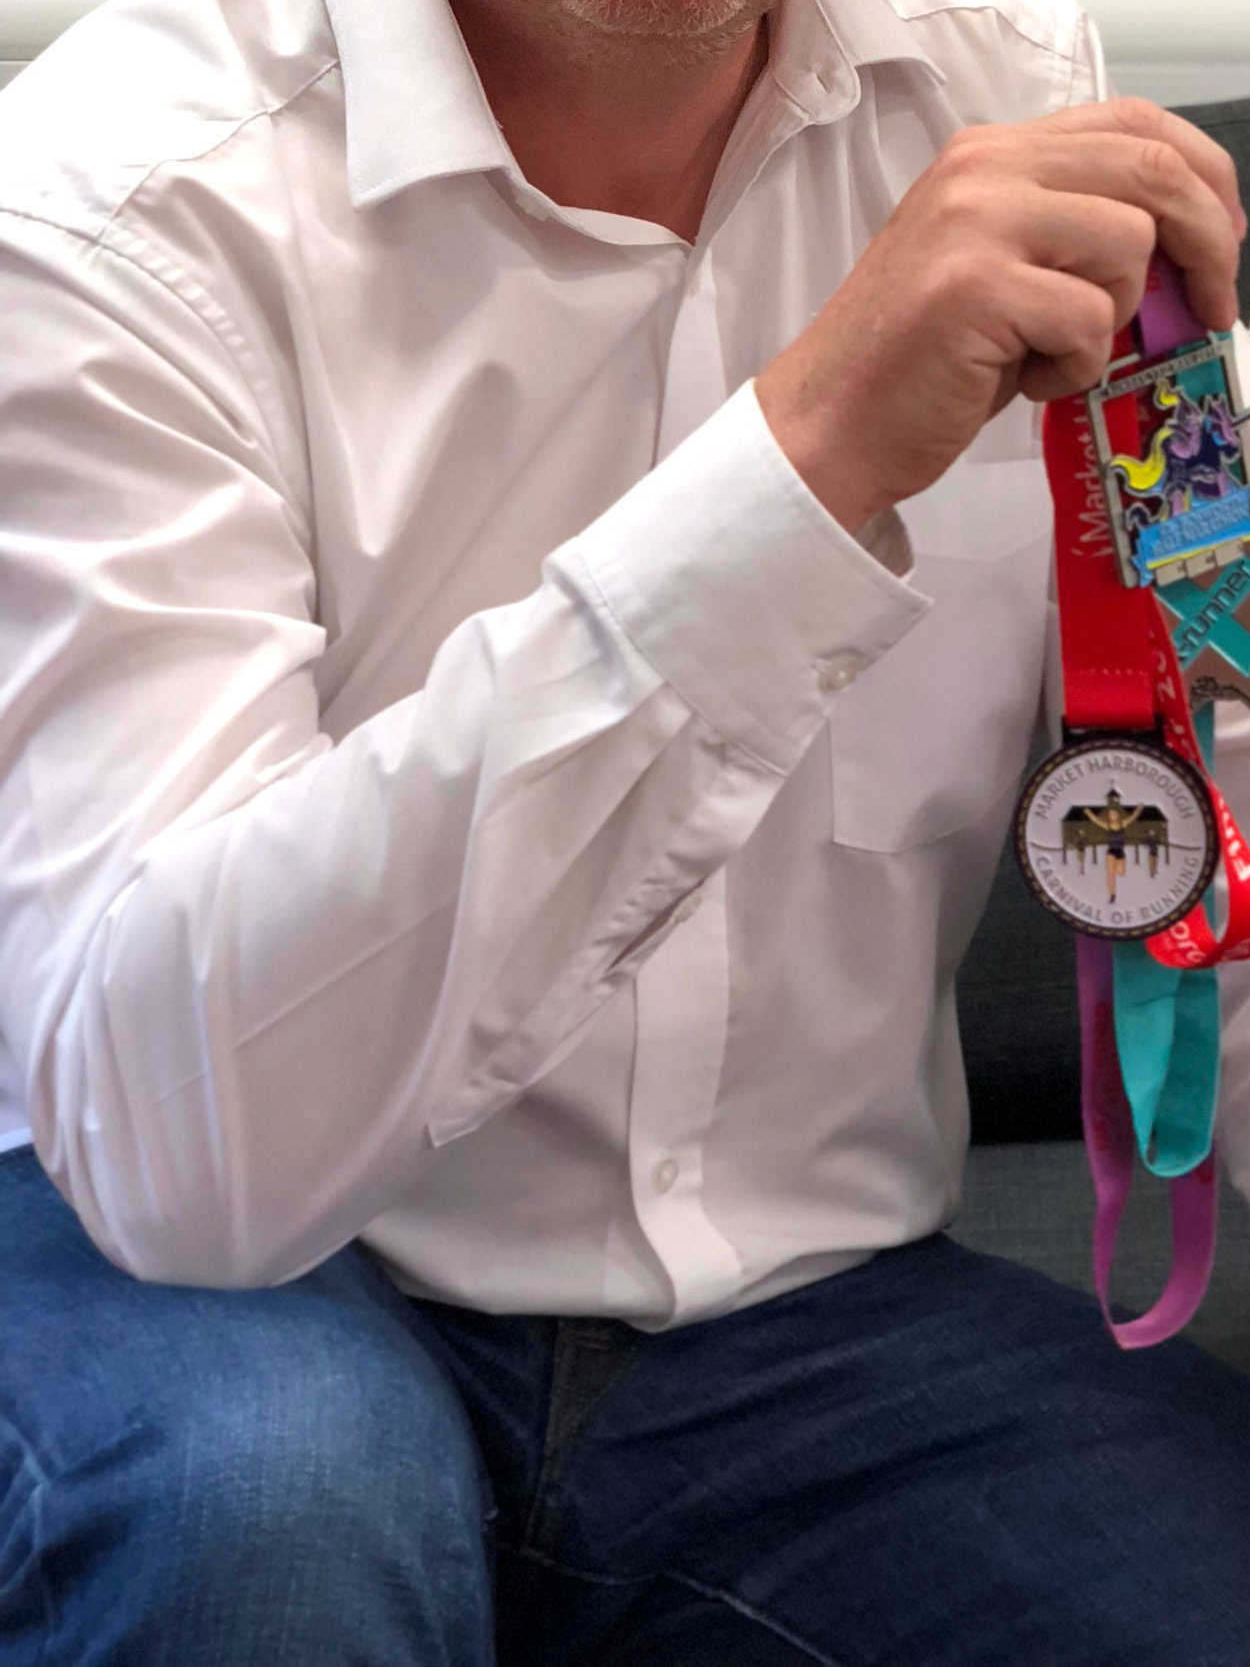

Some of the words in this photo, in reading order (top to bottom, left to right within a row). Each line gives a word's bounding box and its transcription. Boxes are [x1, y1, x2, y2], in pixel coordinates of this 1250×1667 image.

[1034, 759, 1087, 820] MARKET
[1088, 755, 1196, 820] HARBOROUGH
[1034, 855, 1104, 924] CARNIVAL
[1110, 910, 1134, 926] OF
[1138, 854, 1200, 921] RUNNING
